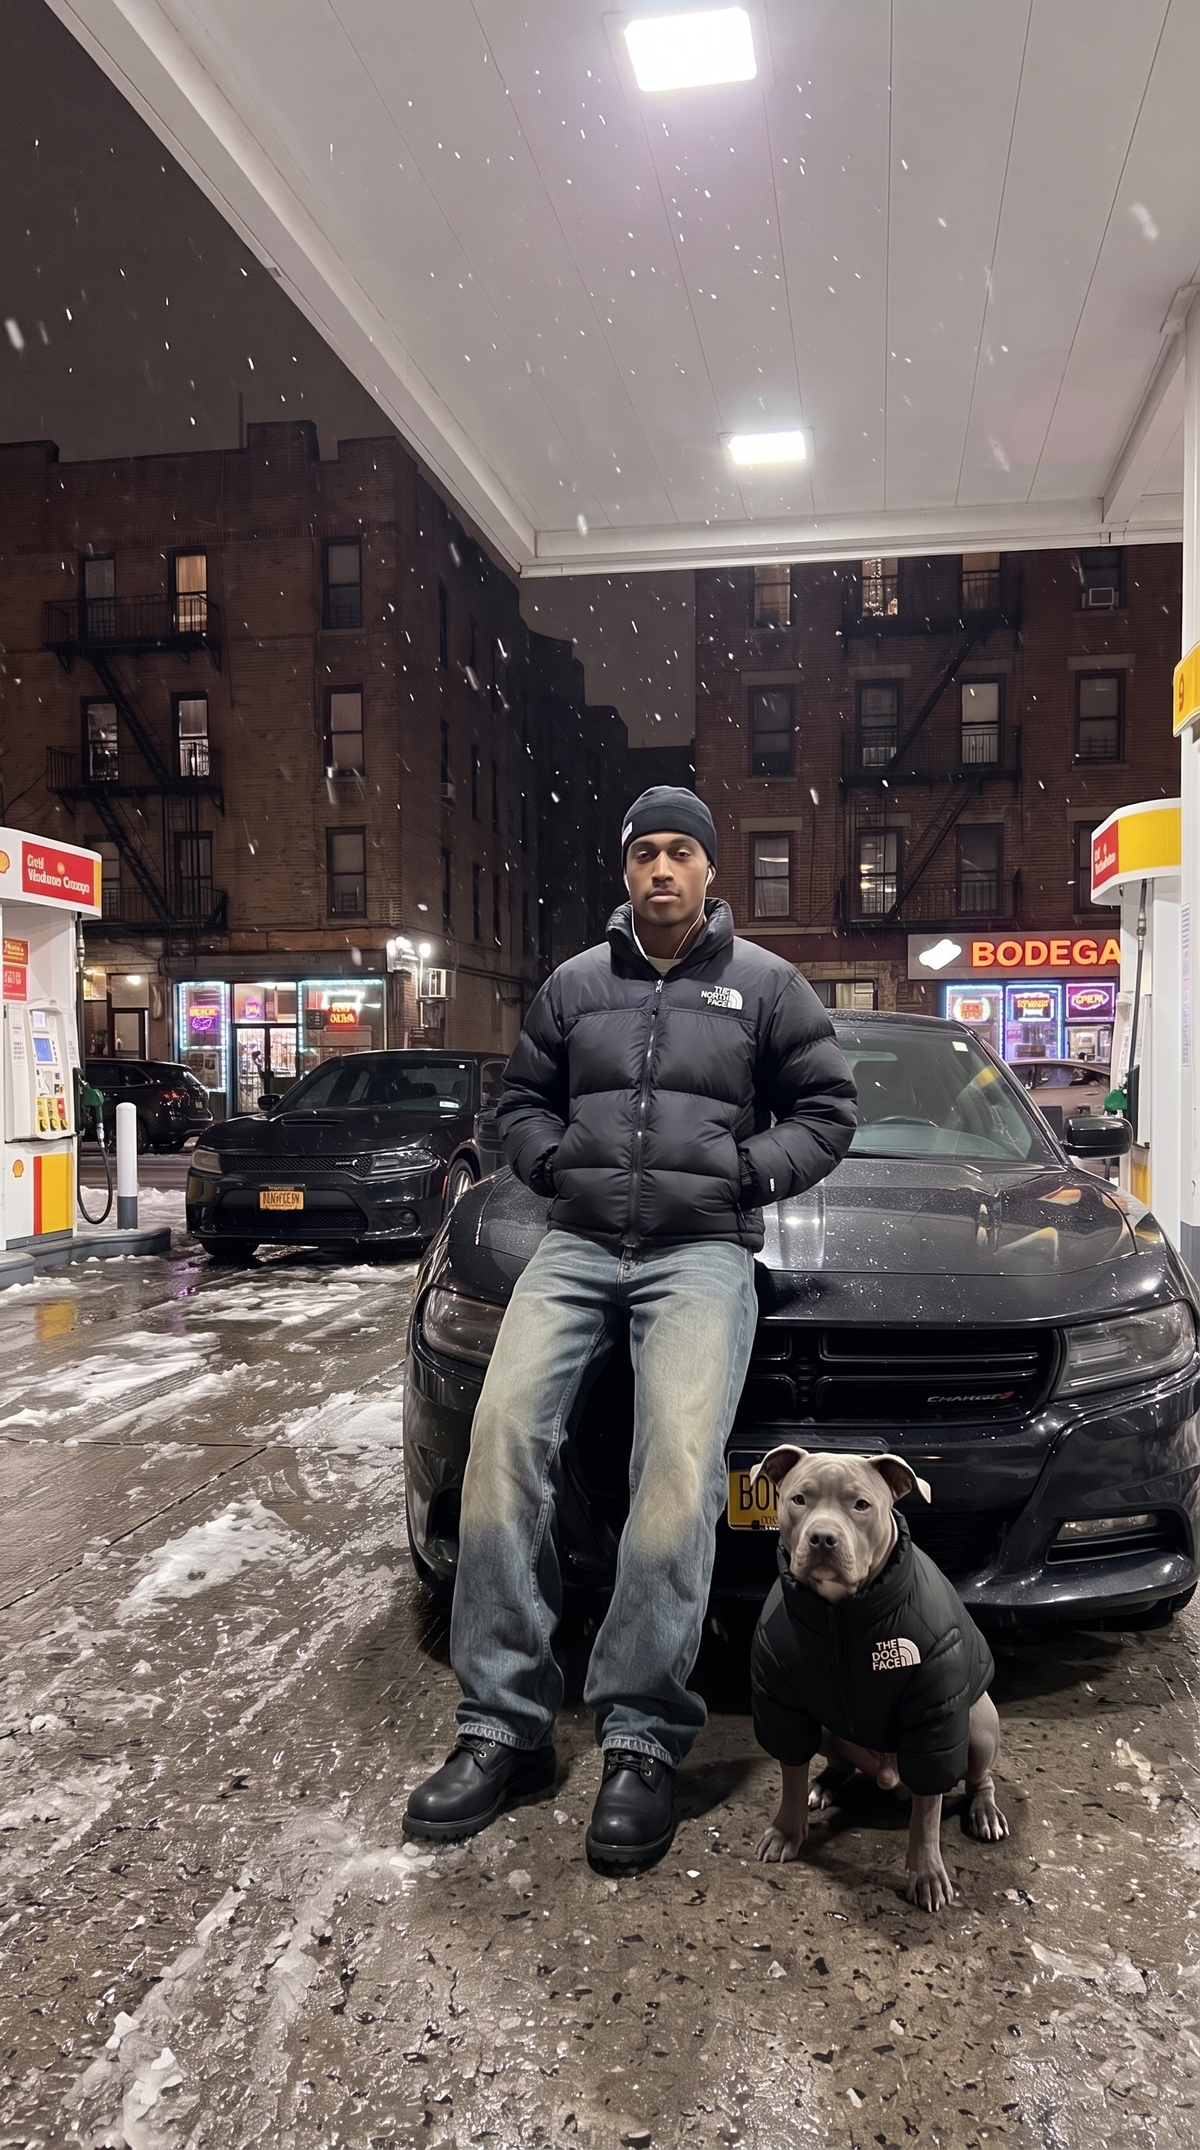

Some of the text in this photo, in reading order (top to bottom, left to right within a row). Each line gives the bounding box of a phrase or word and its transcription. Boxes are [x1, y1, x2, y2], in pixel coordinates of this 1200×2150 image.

[972, 939, 1121, 967] BODEGA
[700, 990, 730, 1001] NORTH
[707, 998, 729, 1008] FACE
[876, 1639, 897, 1651] THE
[872, 1648, 899, 1661] DOG
[872, 1657, 901, 1671] FACE
